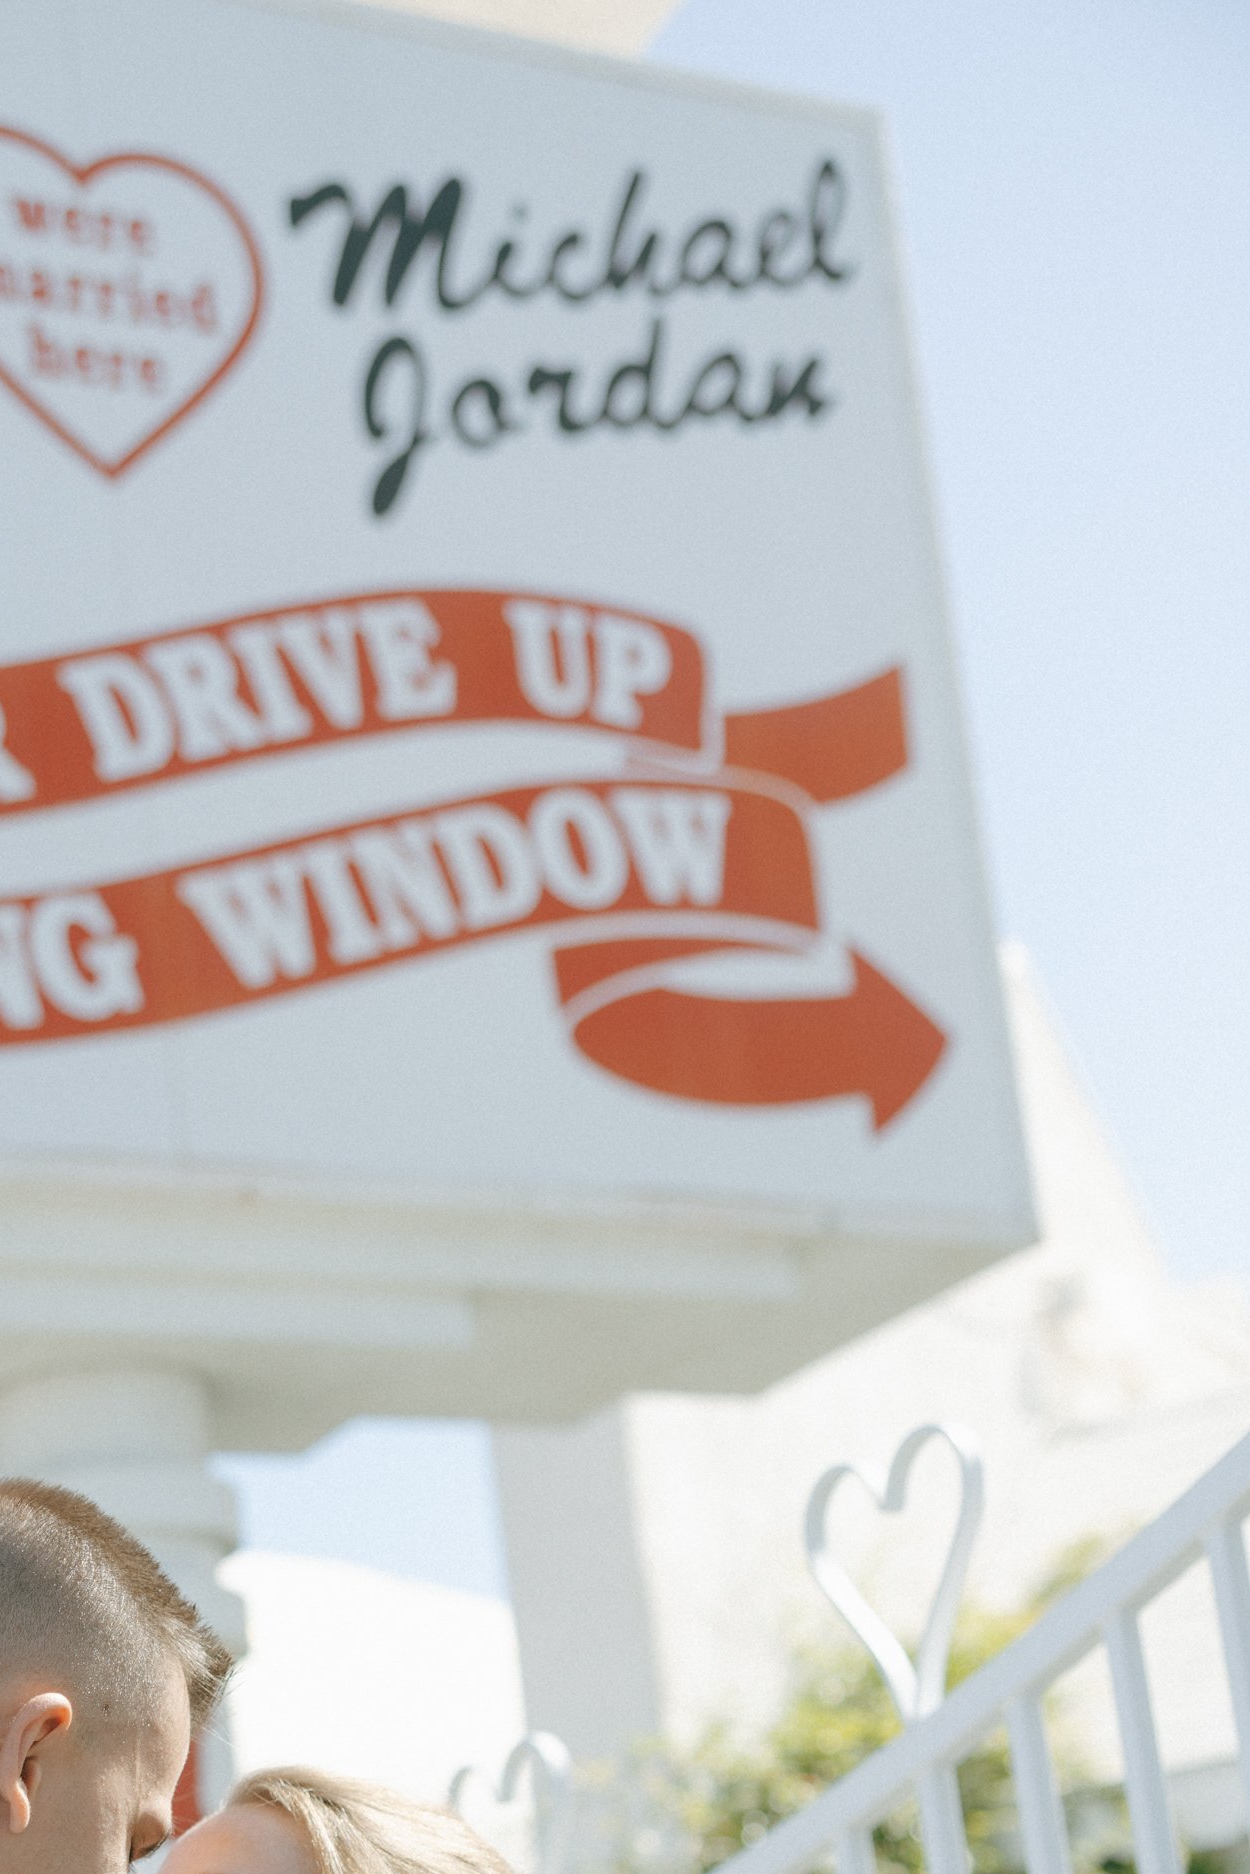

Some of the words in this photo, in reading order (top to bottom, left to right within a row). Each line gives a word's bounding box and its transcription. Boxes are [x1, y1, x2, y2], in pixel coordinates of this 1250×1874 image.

[12, 192, 154, 257] were
[288, 160, 854, 310] Michael
[26, 322, 164, 394] here
[362, 318, 836, 520] Jordan
[58, 599, 455, 781] DRIVE
[503, 597, 674, 732] UP
[181, 784, 731, 989] WINDOW
